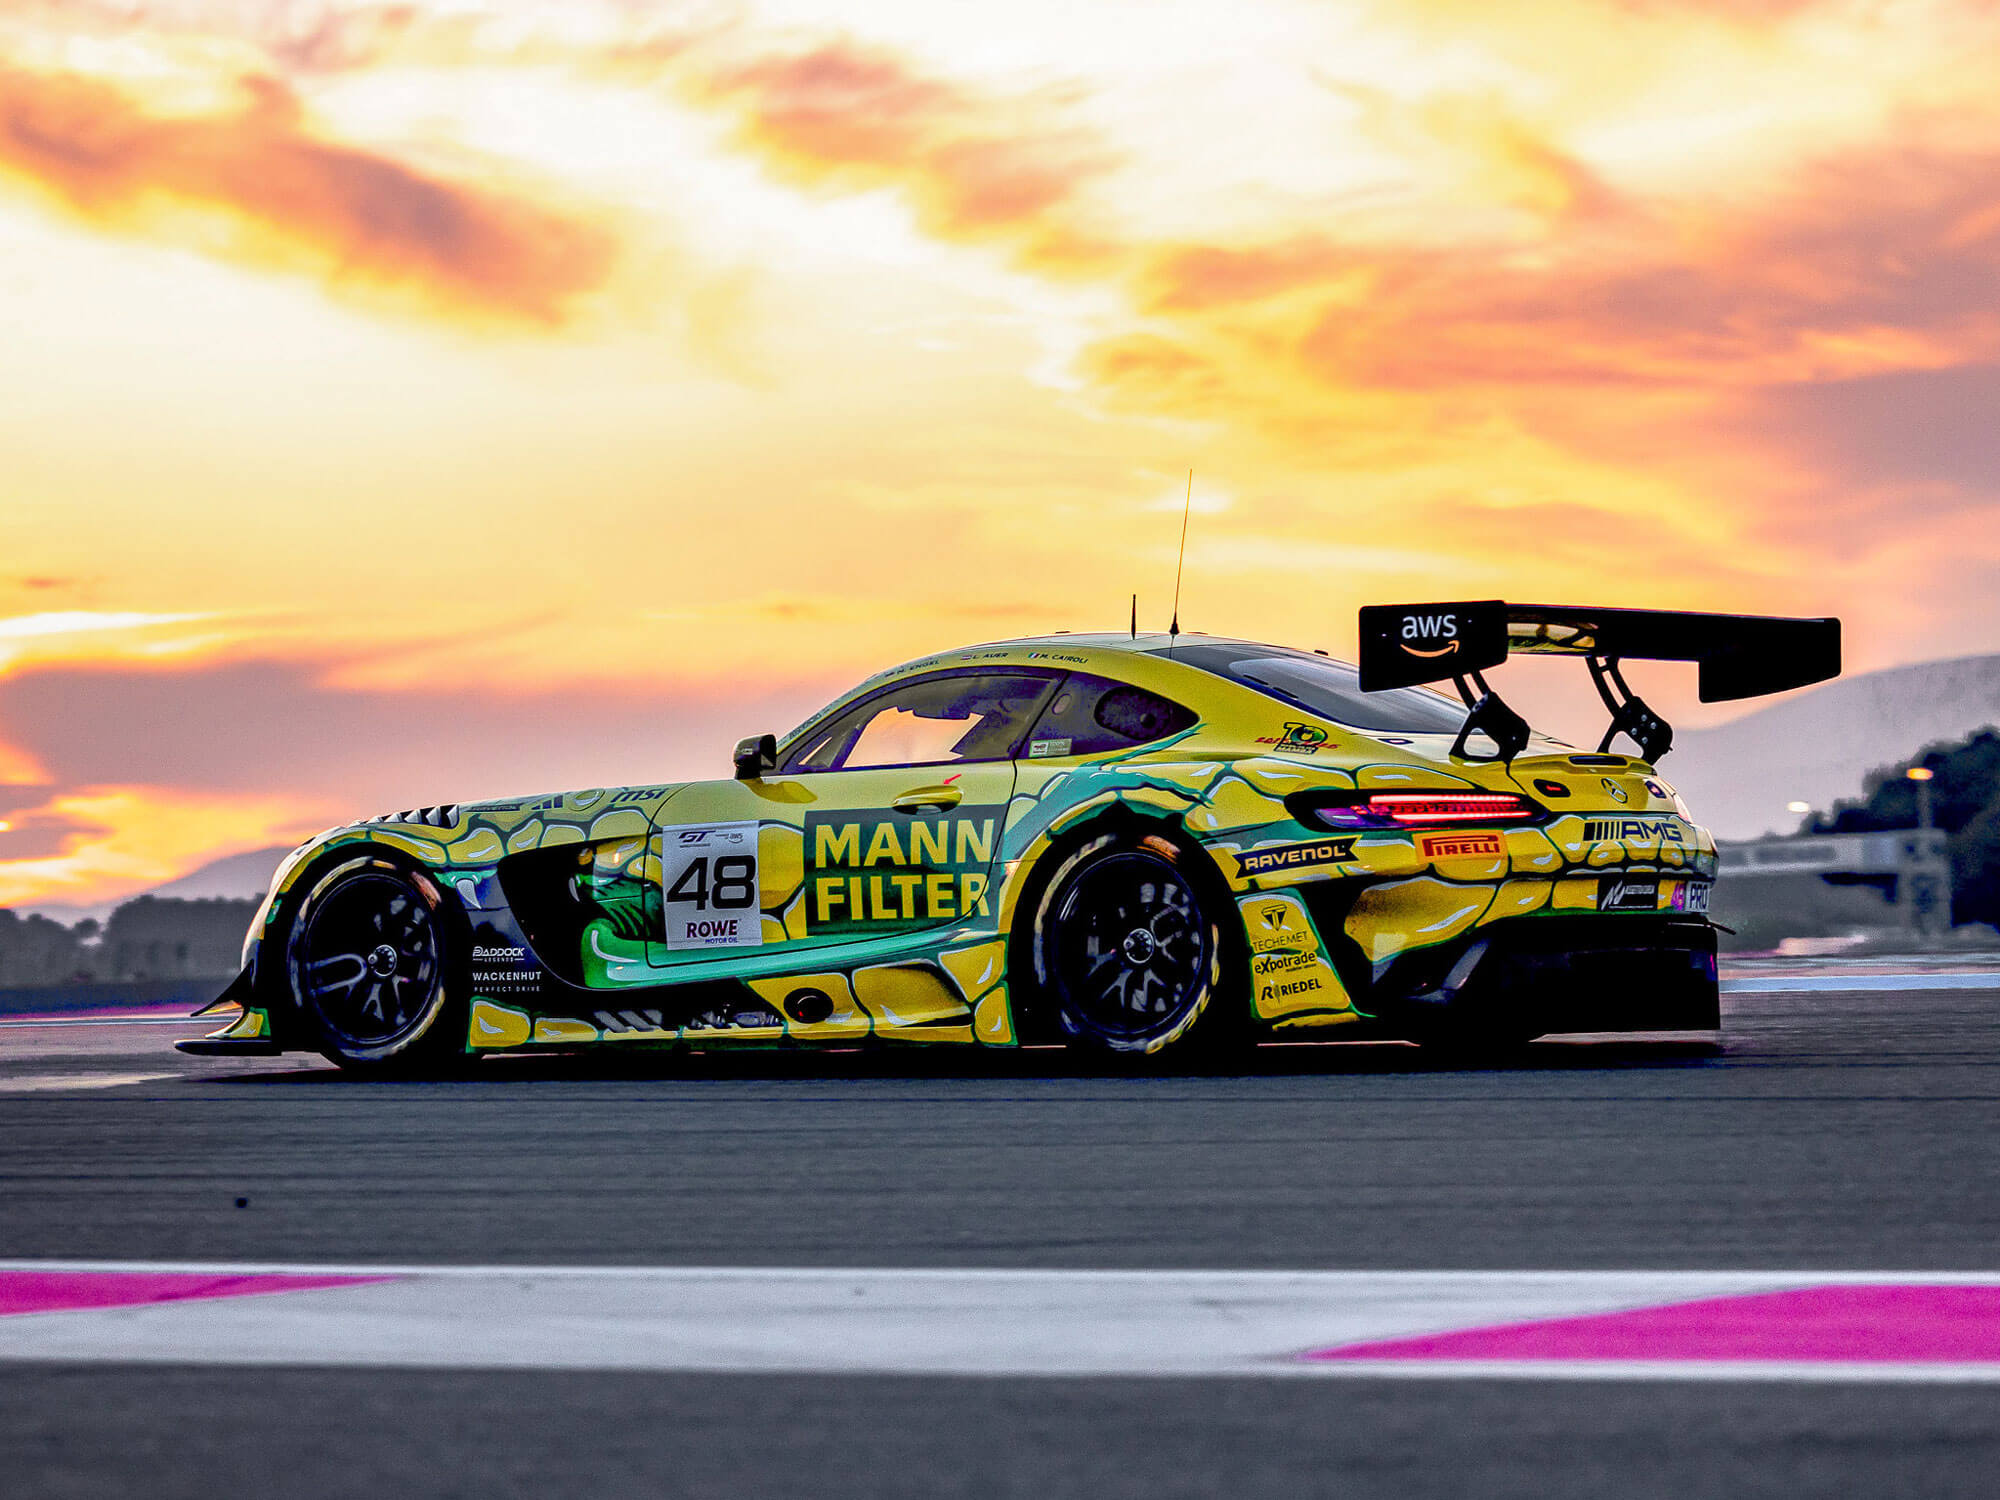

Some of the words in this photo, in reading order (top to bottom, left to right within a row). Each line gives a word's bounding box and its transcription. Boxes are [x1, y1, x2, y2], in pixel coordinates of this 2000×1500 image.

[1401, 613, 1458, 639] aws
[1052, 654, 1089, 664] CAIROLI
[610, 787, 670, 803] msi
[1620, 820, 1683, 842] AMG
[815, 819, 993, 868] MANN
[1422, 835, 1501, 857] PIRELLI
[1244, 845, 1347, 870] RAVENOL
[667, 855, 757, 911] 48
[816, 873, 991, 922] FILTER
[686, 919, 738, 938] ROWE
[1253, 930, 1308, 952] TECHEMET
[472, 971, 542, 981] WACKENHUT
[1280, 977, 1323, 997] RIEDEL
